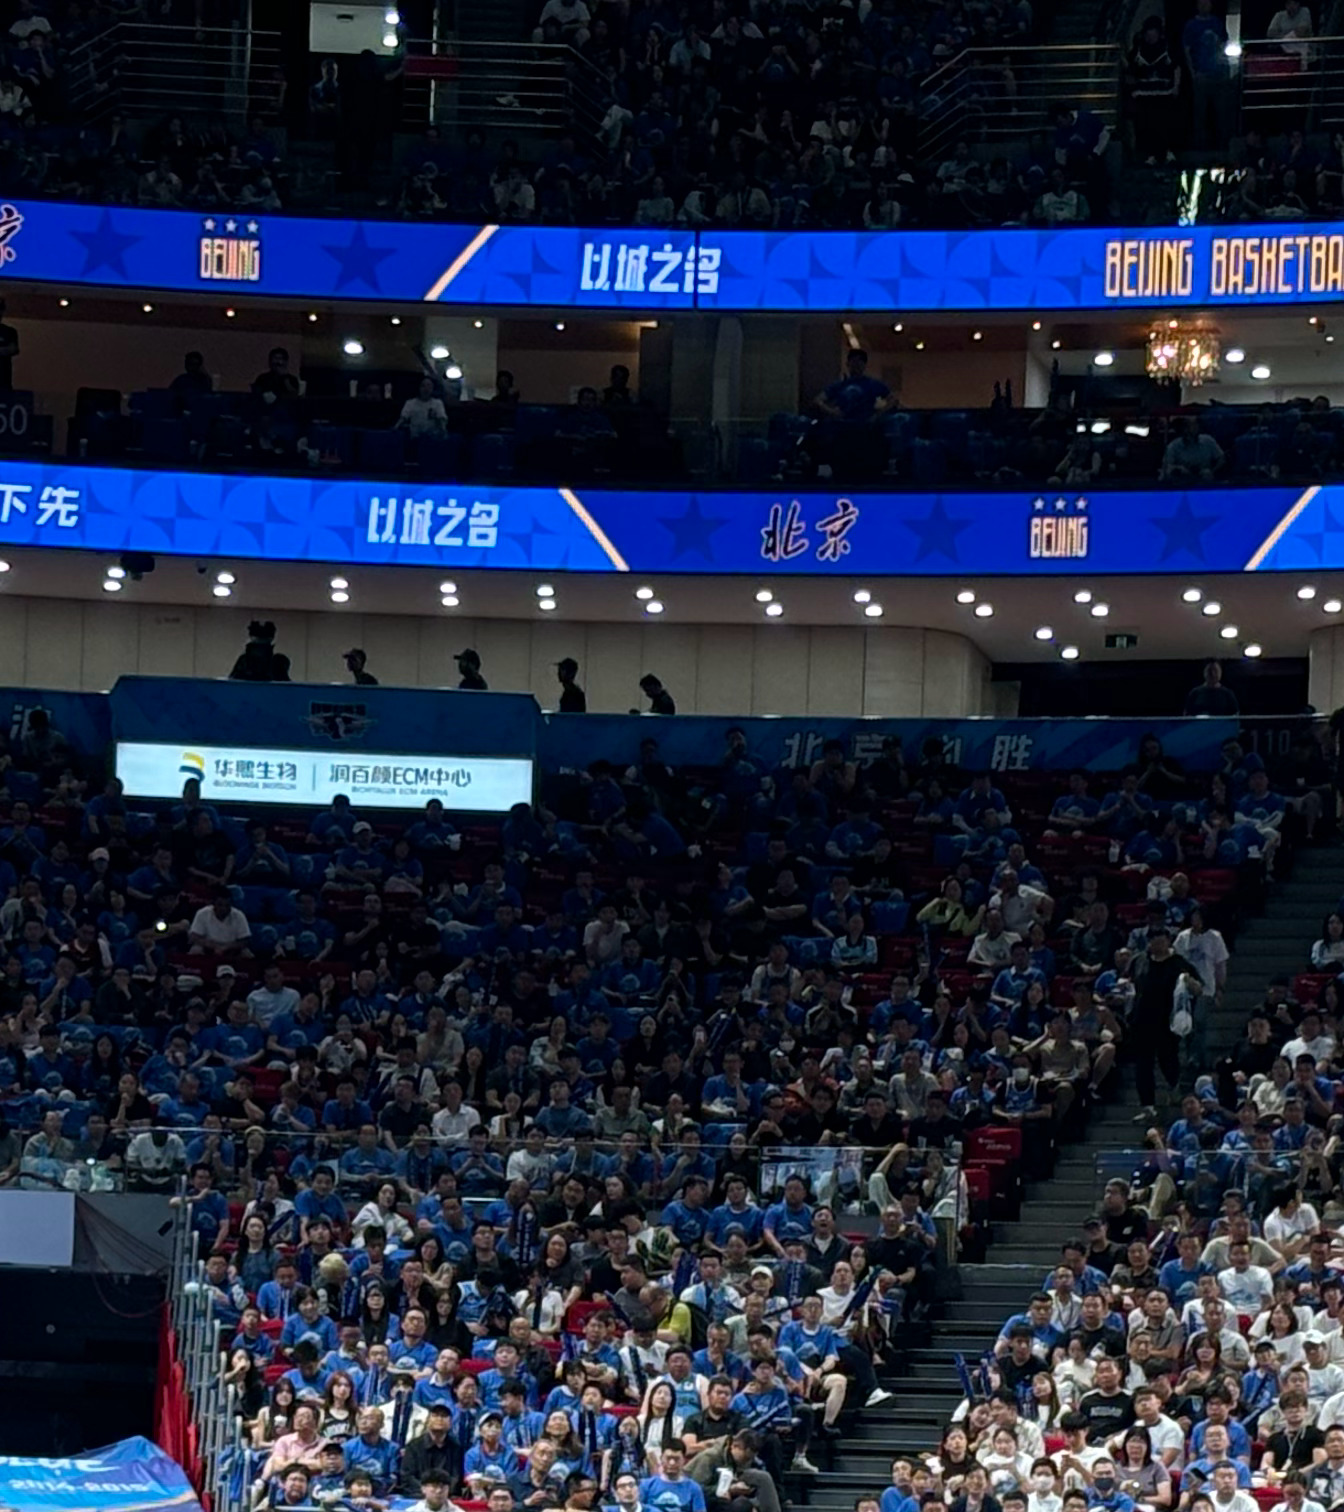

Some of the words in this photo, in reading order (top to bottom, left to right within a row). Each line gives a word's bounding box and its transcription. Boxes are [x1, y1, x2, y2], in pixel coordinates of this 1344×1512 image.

[200, 237, 260, 281] BEIJING
[581, 242, 720, 294] 以城之名
[1106, 239, 1192, 296] BEIJING
[367, 497, 499, 547] 以城之名
[761, 499, 858, 563] 北京
[1030, 517, 1088, 558] BEIJING
